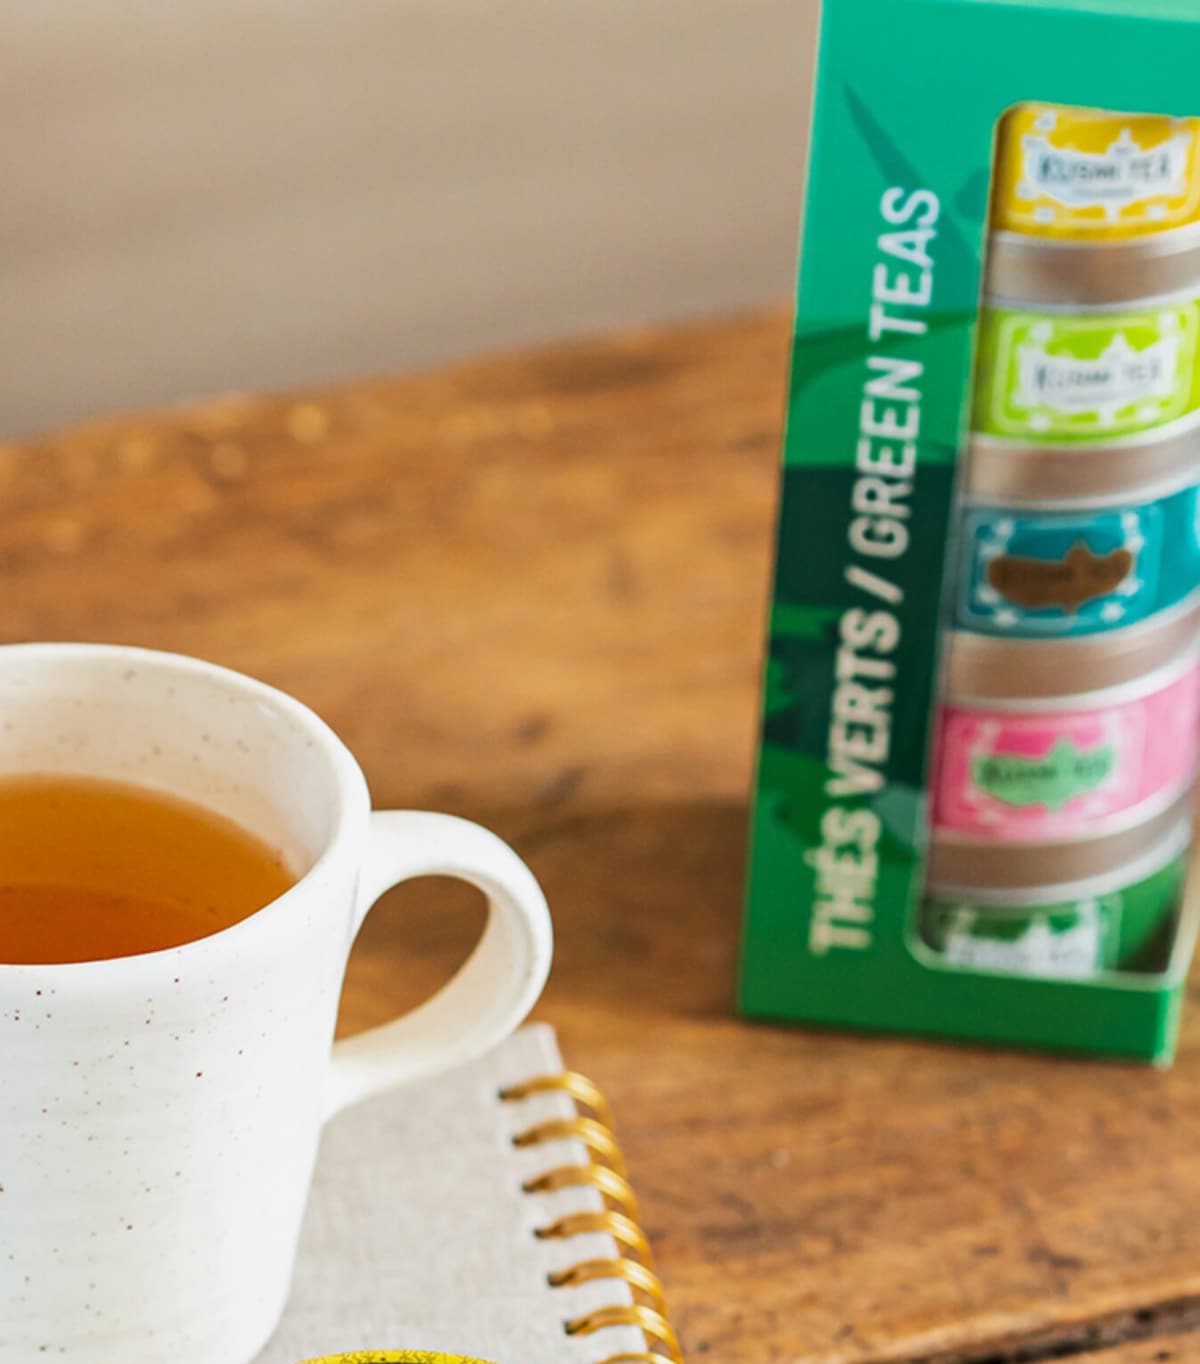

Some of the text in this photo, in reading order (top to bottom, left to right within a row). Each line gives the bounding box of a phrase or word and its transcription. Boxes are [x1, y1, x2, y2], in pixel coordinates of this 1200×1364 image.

[806, 187, 940, 955] THÉS VERTS / GREEN TEAS
